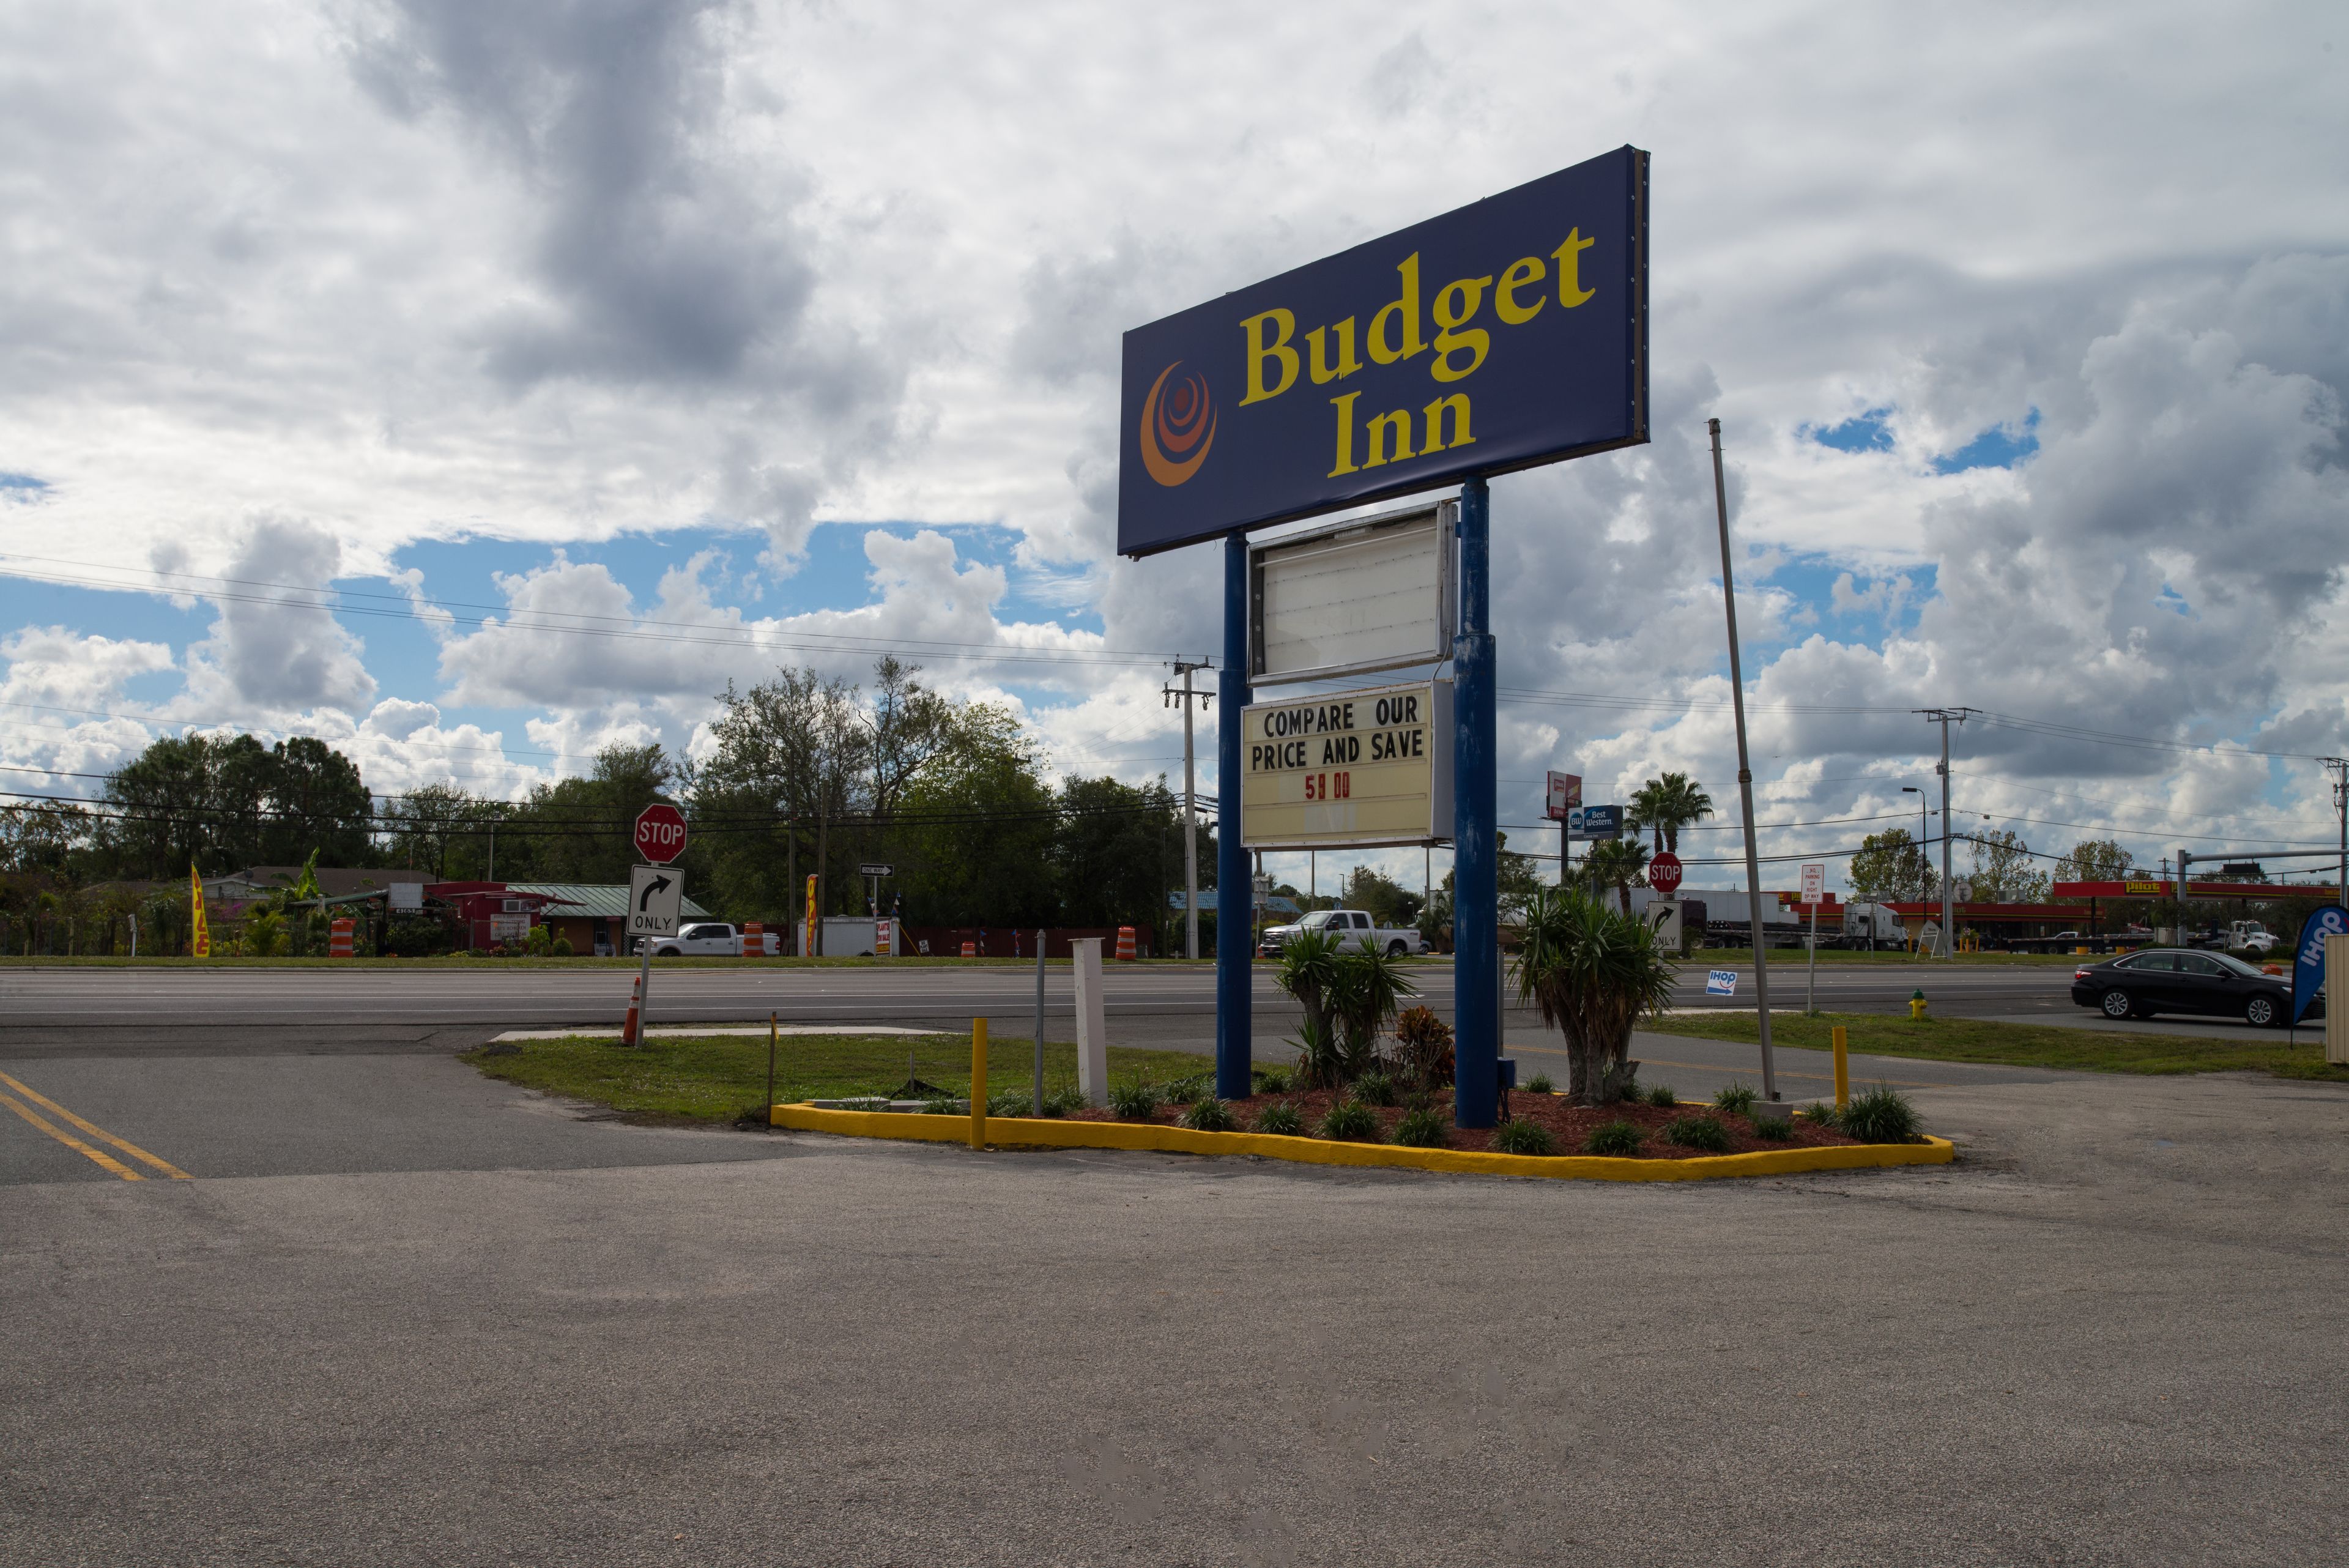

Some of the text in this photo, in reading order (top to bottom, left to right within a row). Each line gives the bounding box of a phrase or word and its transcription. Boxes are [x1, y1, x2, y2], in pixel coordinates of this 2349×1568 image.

[1238, 226, 1597, 408] Budget
[1327, 390, 1477, 479] Inn
[1263, 696, 1418, 738] COMPARE OUR
[1252, 729, 1423, 771] PRICE AND SAVE
[639, 821, 683, 845] STOP
[1652, 864, 1680, 881] STOP
[2125, 882, 2161, 893] Pilot
[635, 915, 672, 931] ONLY
[1652, 936, 1676, 946] ONLY
